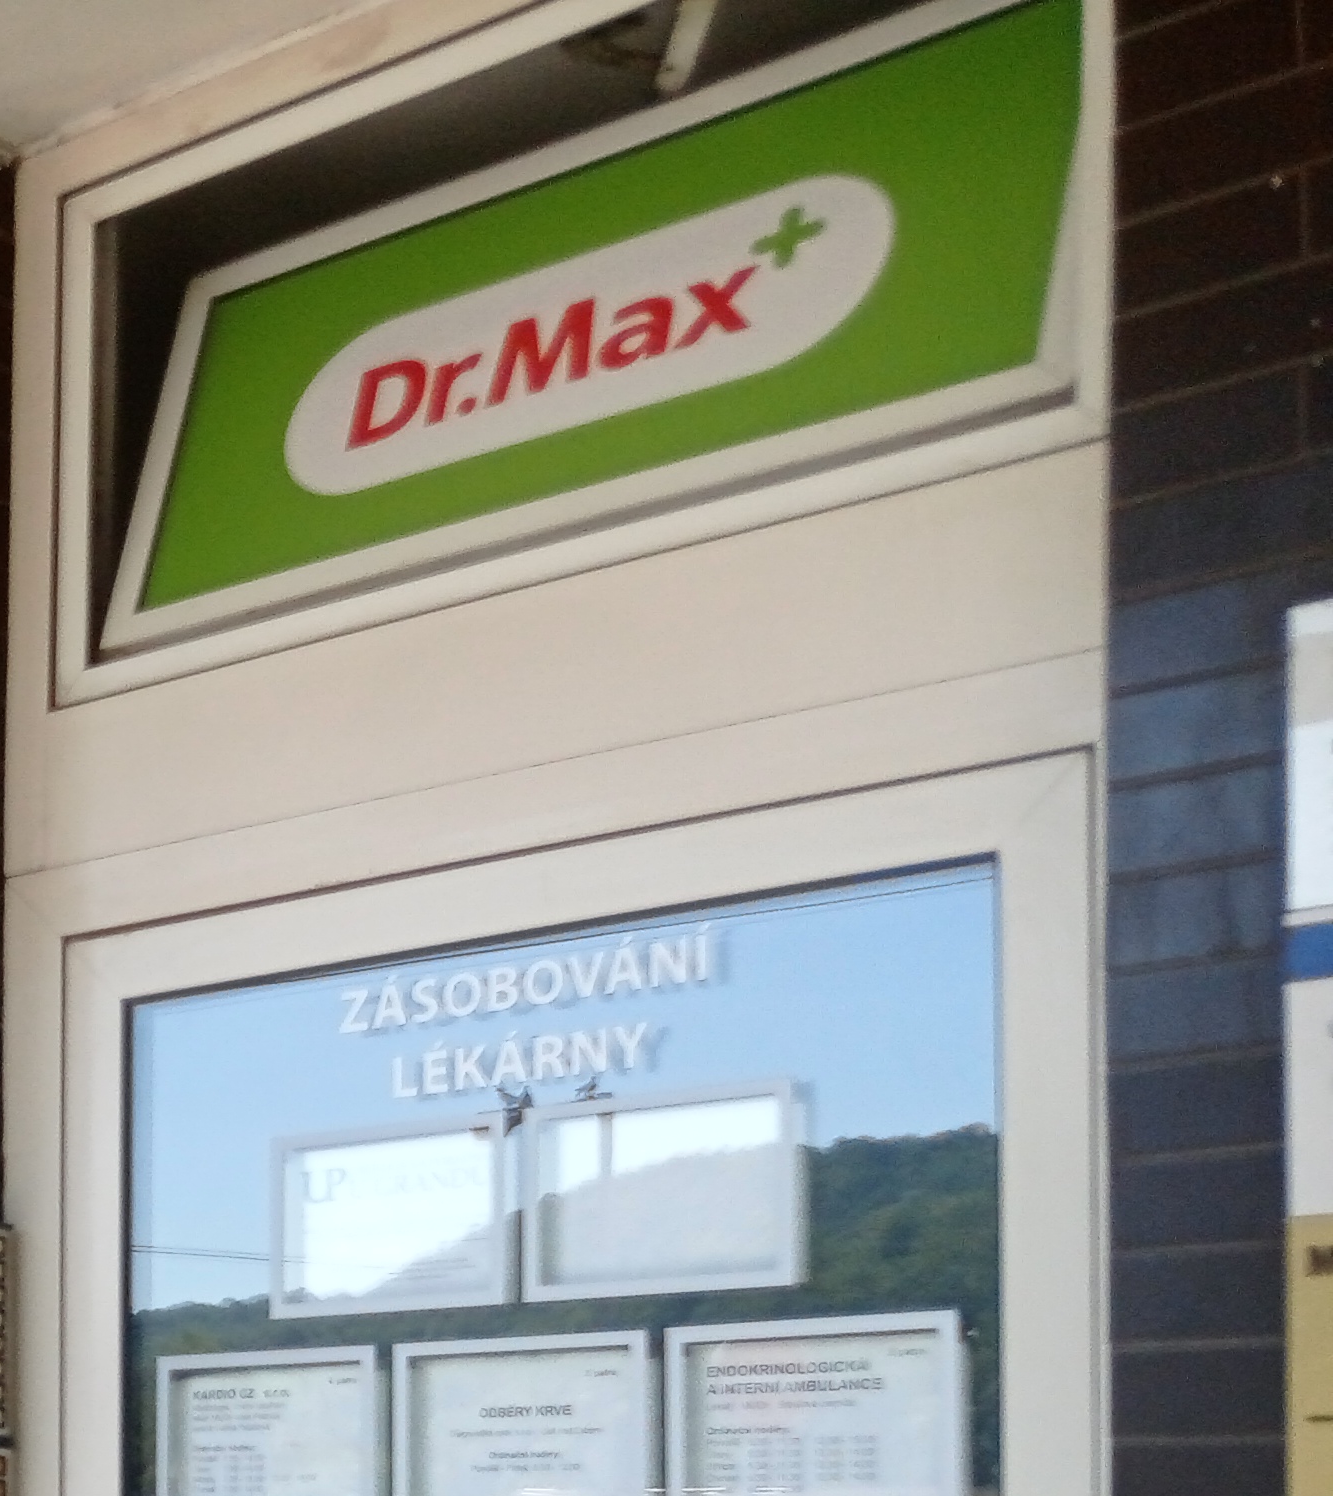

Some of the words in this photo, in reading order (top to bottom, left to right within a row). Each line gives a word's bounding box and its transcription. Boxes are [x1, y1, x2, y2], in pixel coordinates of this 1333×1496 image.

[337, 922, 714, 1036] ZÁSOBOVÁNÍ
[390, 1021, 650, 1100] LÉKÁRNY
[534, 1403, 573, 1417] KRVE
